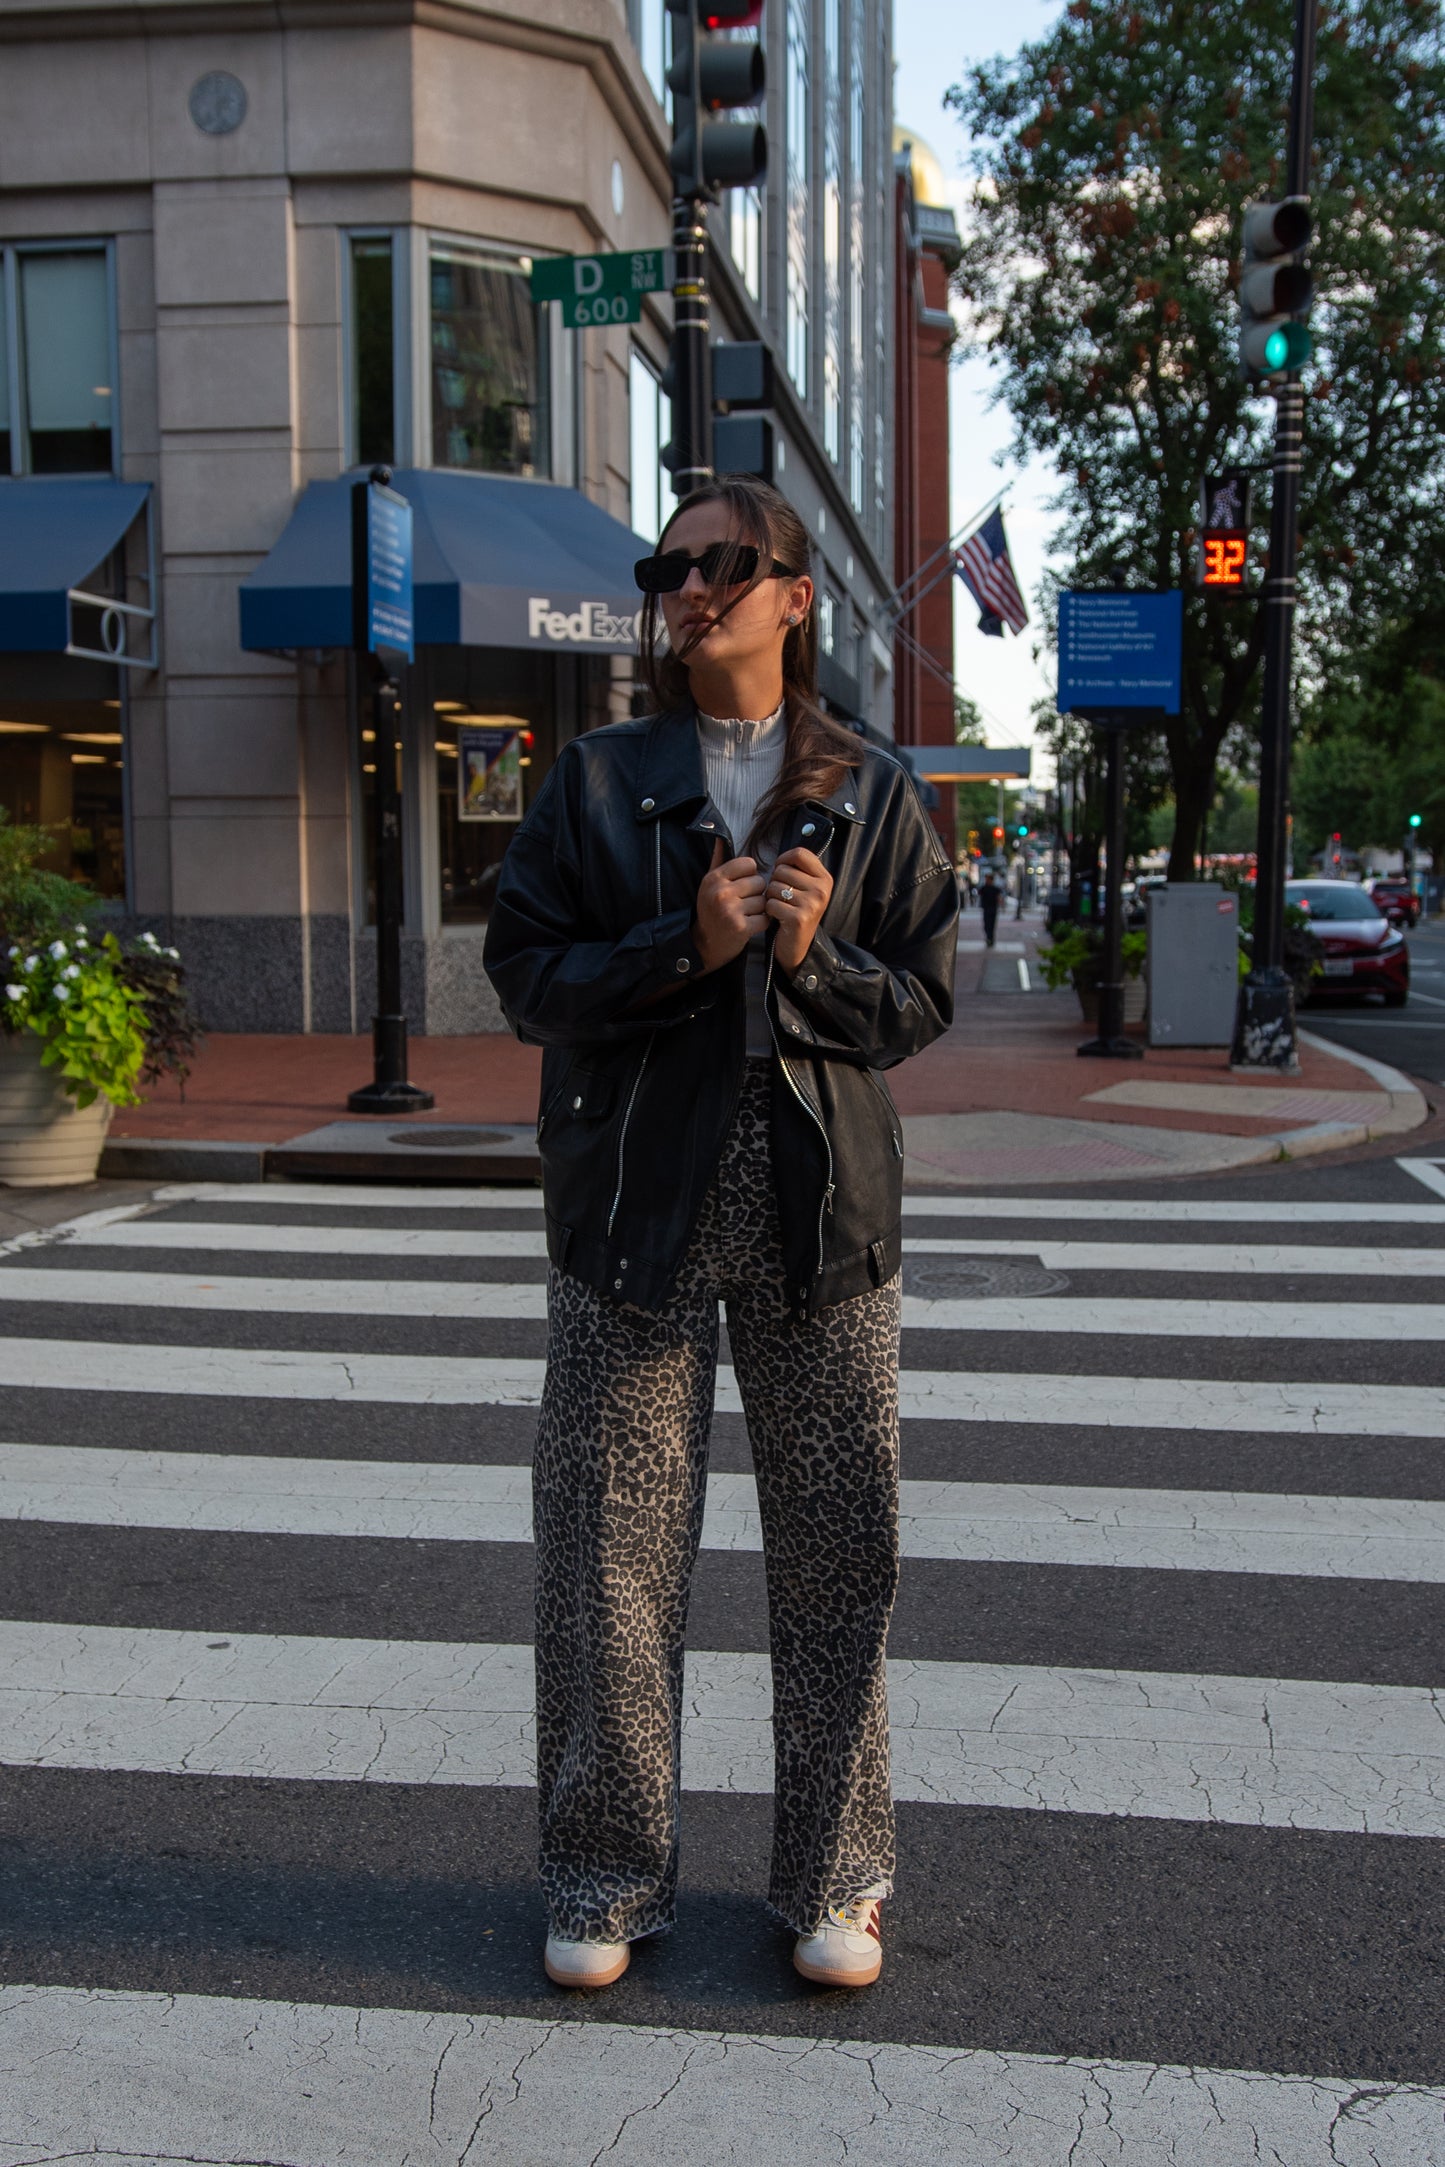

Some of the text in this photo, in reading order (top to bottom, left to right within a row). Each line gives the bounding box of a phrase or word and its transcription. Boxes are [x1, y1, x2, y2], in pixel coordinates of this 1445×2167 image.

[573, 253, 657, 295] D ST
[631, 272, 657, 290] NW
[574, 296, 629, 324] 600
[1204, 540, 1245, 583] 32
[528, 597, 634, 644] FedEx
